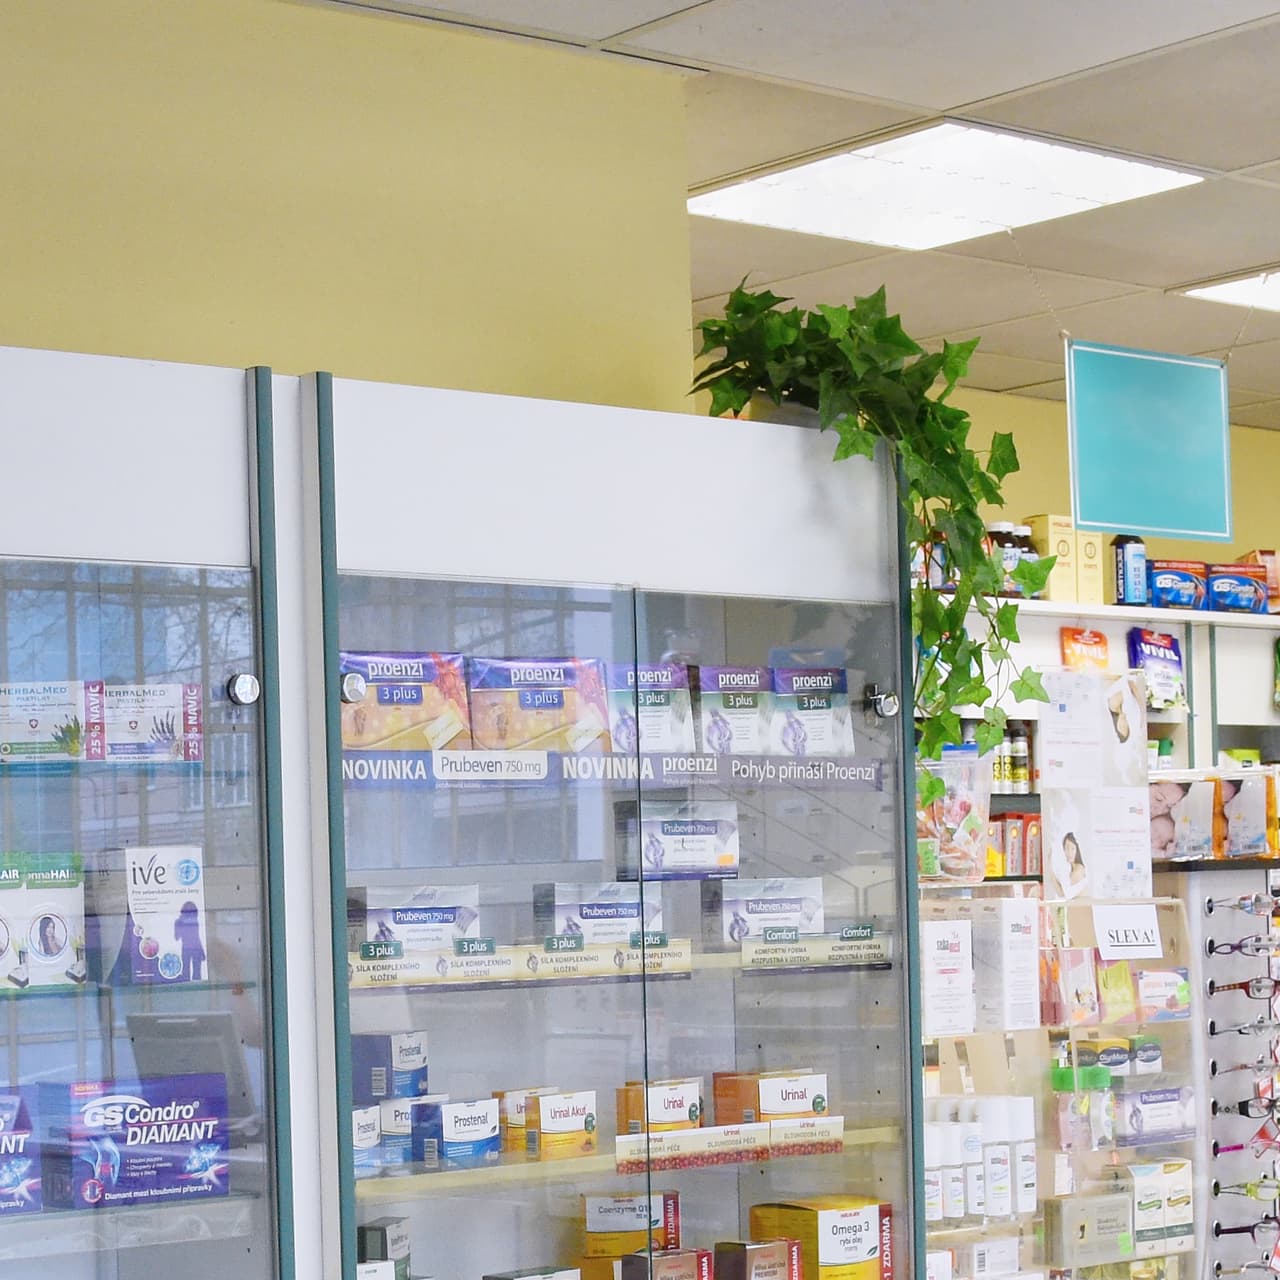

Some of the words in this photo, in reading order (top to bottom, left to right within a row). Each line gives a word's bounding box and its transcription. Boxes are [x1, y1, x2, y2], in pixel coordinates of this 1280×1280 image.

[368, 663, 423, 679] proenzi
[511, 668, 564, 684] proenzi
[719, 671, 759, 688] proenzi
[383, 688, 390, 699] 3
[393, 686, 416, 701] plus
[525, 692, 531, 703] 3
[535, 691, 558, 705] plus
[342, 759, 426, 780] NOVINKA
[441, 756, 502, 773] Prubeven
[505, 760, 521, 771] 750
[524, 763, 541, 775] mg
[662, 755, 718, 774] proenzi
[731, 760, 775, 781] Pohyb
[779, 761, 824, 783] přináší
[826, 762, 875, 781] Proenzi
[396, 910, 430, 922] Prubeven
[1108, 930, 1156, 943] SLEVA!
[377, 944, 395, 957] plus
[781, 1088, 807, 1101] Urinal
[664, 1095, 685, 1110] Urinal
[85, 1106, 123, 1127] GS
[125, 1101, 194, 1123] Condro
[454, 1112, 488, 1127] Prostenal
[550, 1107, 569, 1120] Urinal
[570, 1105, 586, 1117] Akut
[126, 1121, 217, 1145] DIAMANT
[832, 1224, 861, 1237] Omega
